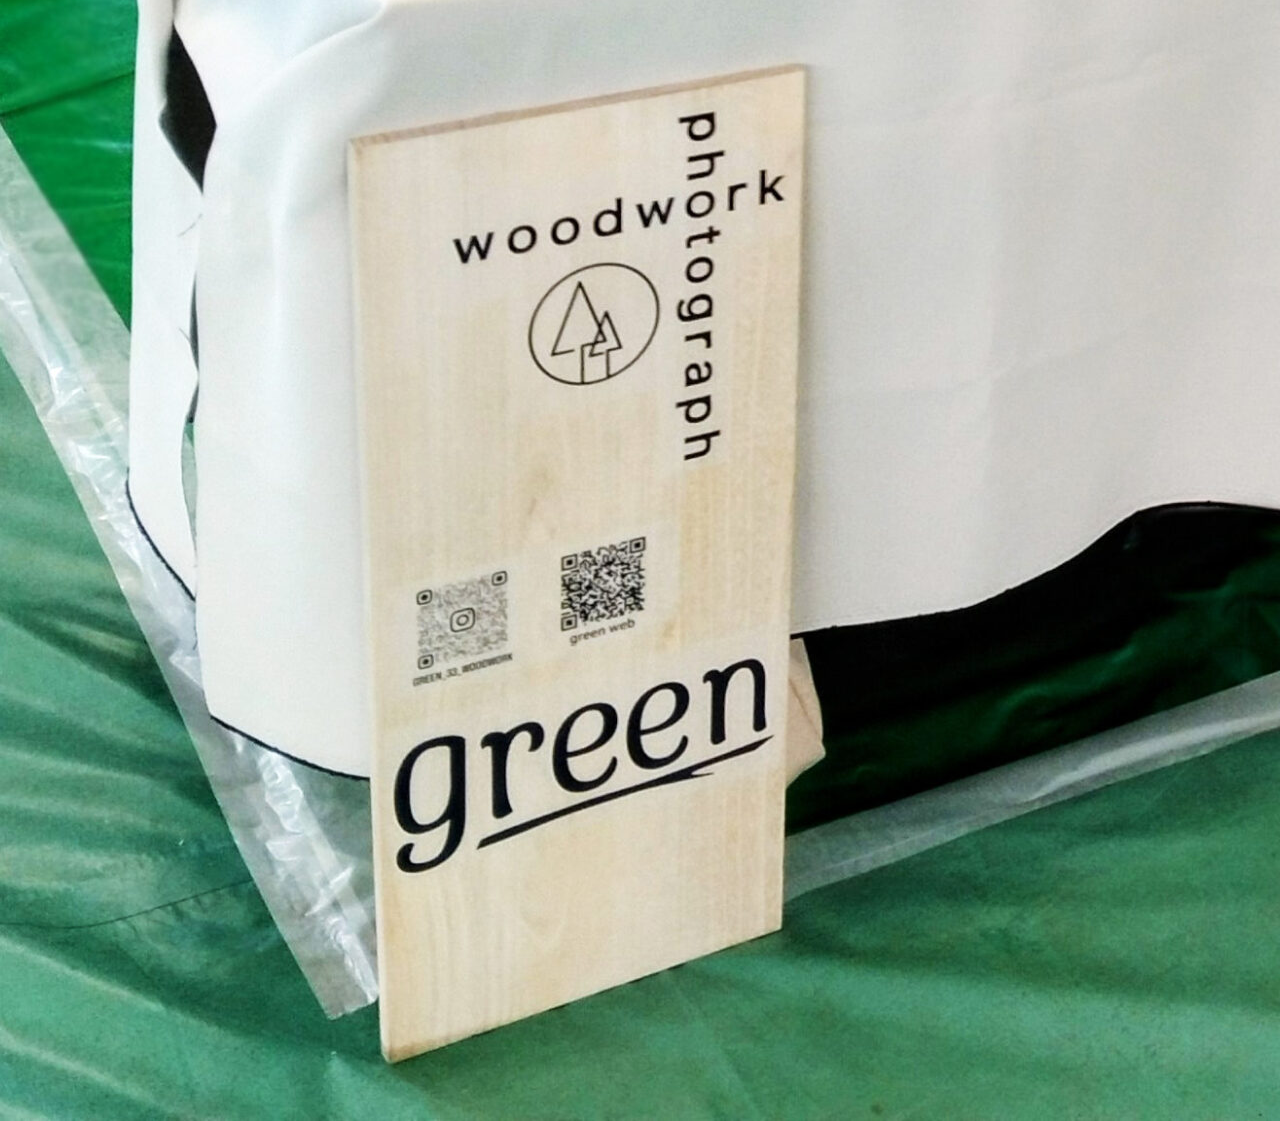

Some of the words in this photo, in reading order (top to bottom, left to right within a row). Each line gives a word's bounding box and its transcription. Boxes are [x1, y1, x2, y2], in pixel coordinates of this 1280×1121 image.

[453, 170, 785, 264] woodwork
[676, 112, 725, 461] photograph
[569, 625, 606, 646] green
[609, 618, 636, 633] web
[393, 658, 769, 874] green
